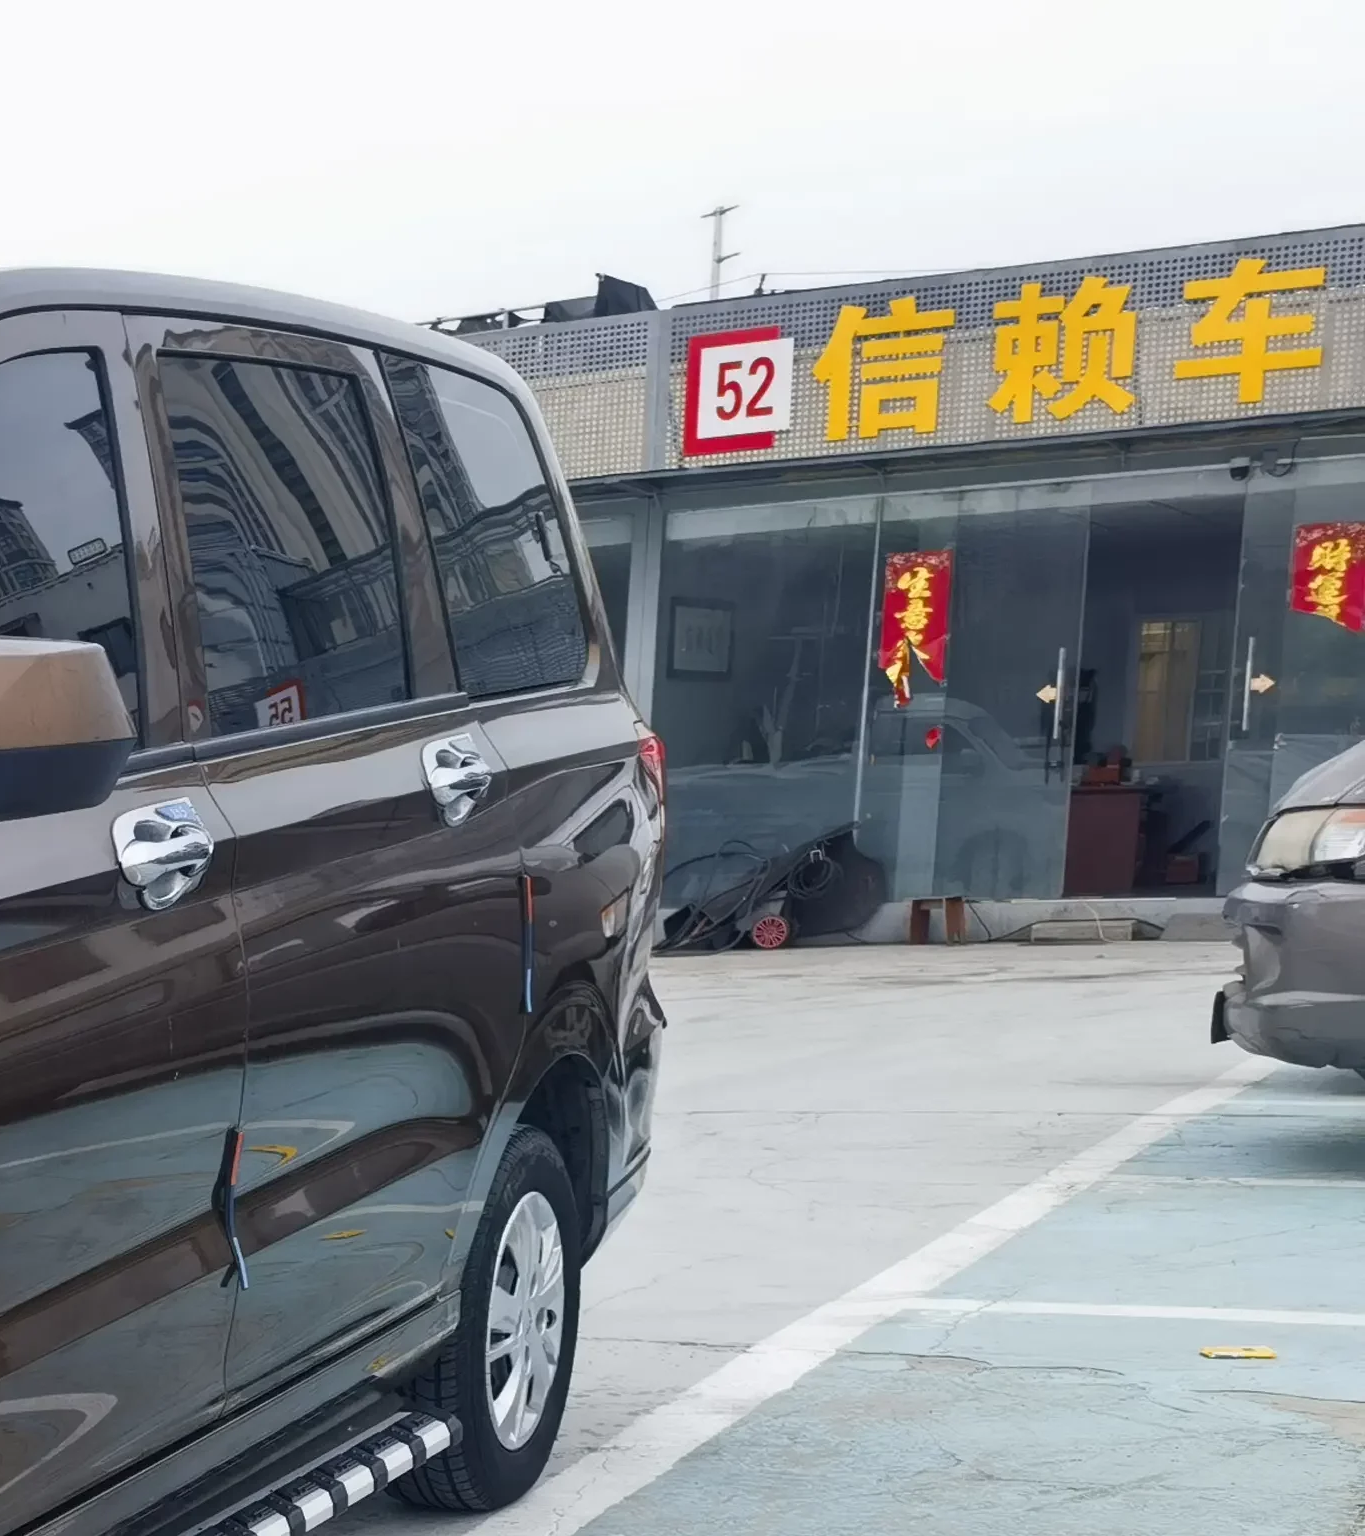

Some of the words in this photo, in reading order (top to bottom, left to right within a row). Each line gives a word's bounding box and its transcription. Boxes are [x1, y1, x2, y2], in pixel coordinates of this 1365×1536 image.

[715, 356, 775, 421] 52
[812, 258, 1326, 441] 信赖车
